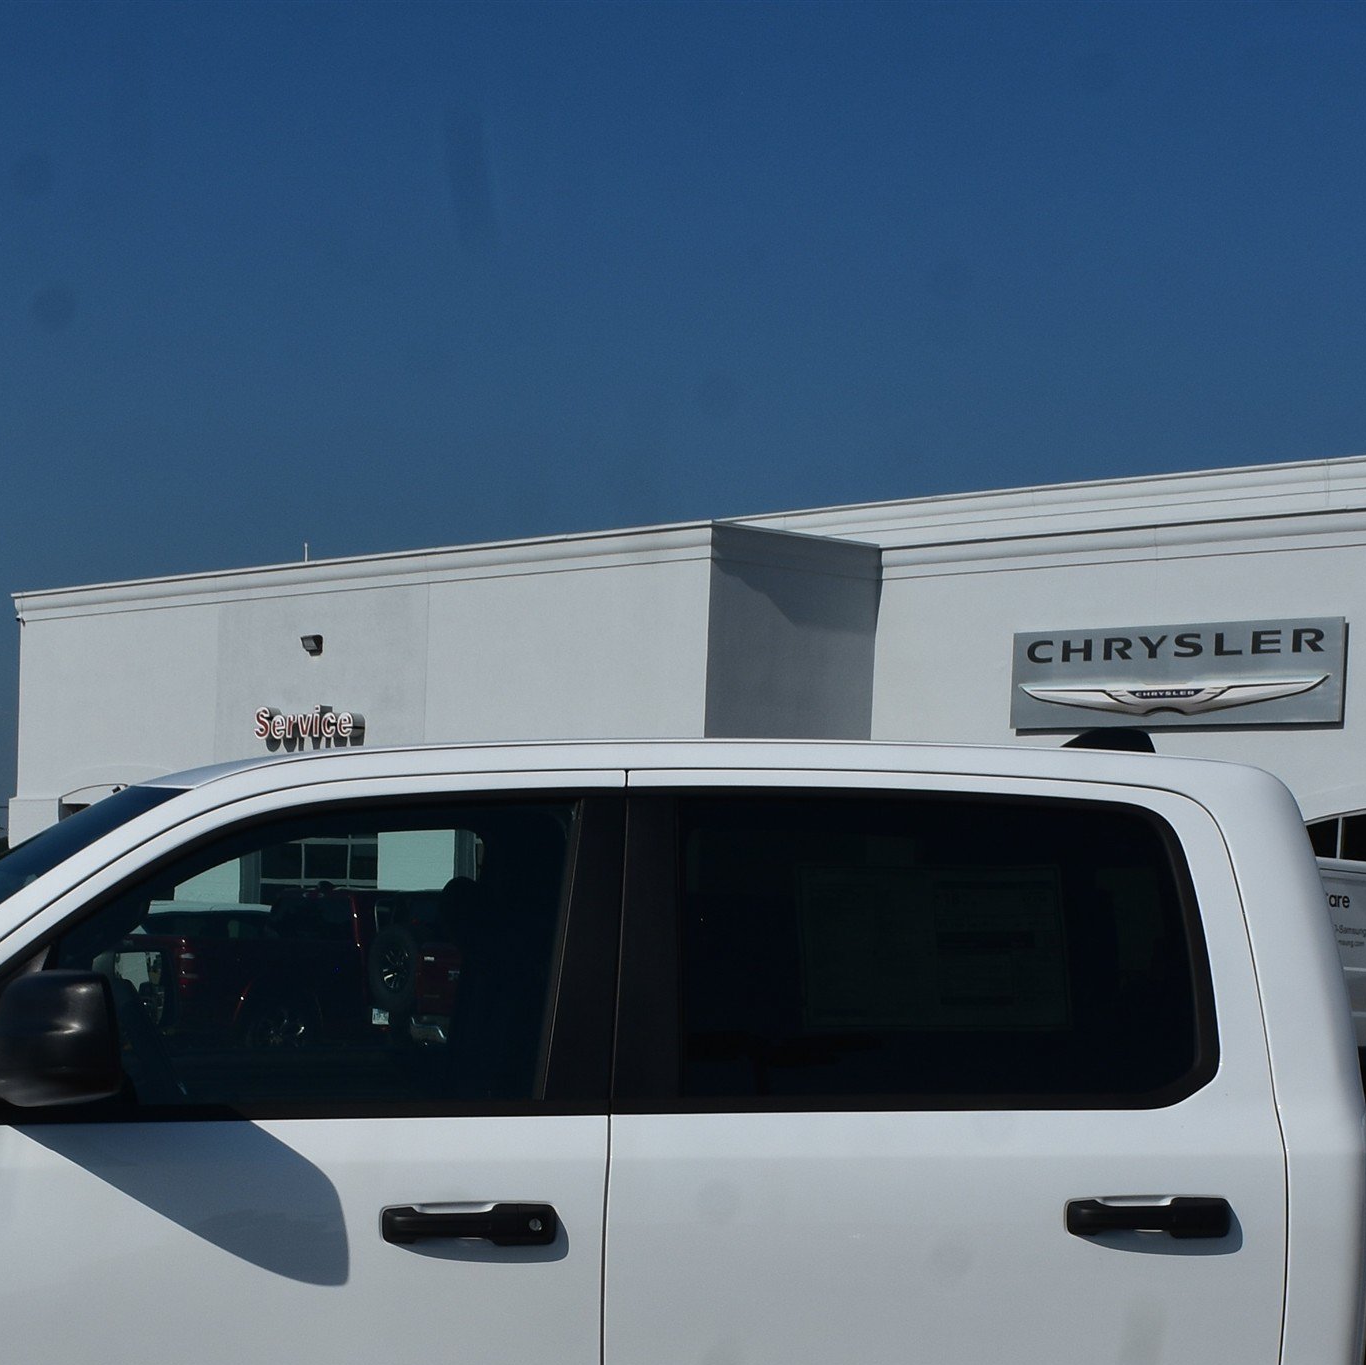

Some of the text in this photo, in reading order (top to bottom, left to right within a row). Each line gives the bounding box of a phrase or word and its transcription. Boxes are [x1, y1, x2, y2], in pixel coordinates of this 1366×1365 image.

[1026, 627, 1326, 665] CHRYSLER
[254, 704, 355, 740] Service
[1325, 892, 1350, 909] are
